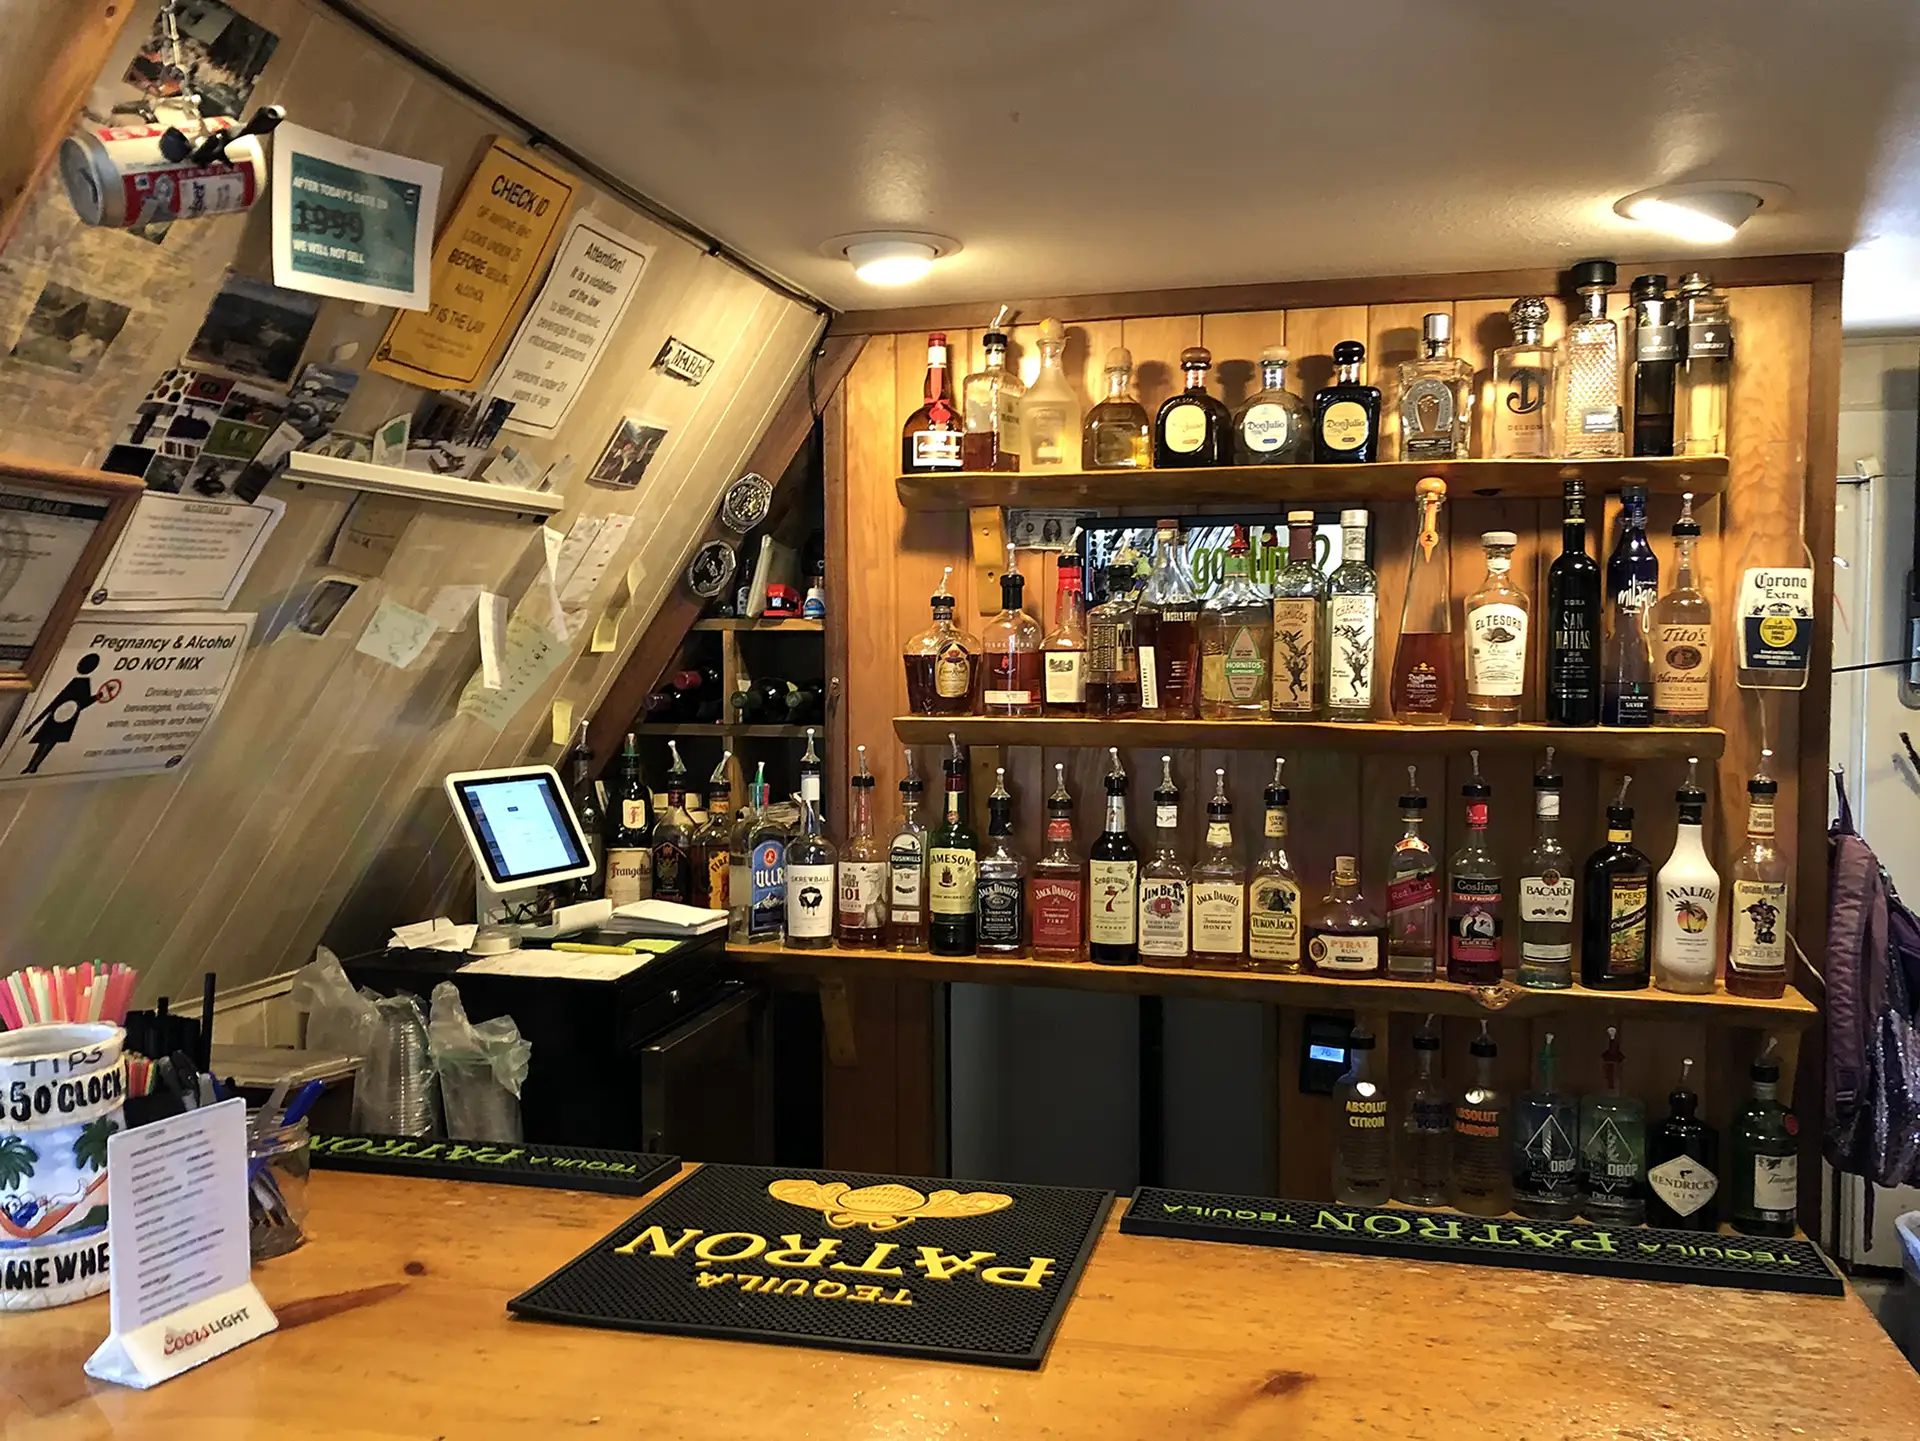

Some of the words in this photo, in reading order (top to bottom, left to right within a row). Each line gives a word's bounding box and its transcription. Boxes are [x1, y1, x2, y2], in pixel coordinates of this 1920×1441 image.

[491, 175, 535, 214] CHECK
[536, 199, 550, 217] ID
[293, 240, 306, 252] WE
[308, 242, 328, 257] WILL
[347, 249, 365, 264] SELL
[584, 242, 628, 274] Attention!
[448, 248, 488, 276] BEFORE
[588, 275, 618, 295] violation
[568, 288, 578, 298] of
[578, 290, 589, 304] the
[588, 296, 601, 308] law
[450, 311, 470, 330] THE
[1755, 572, 1808, 588] Corona
[1766, 589, 1799, 600] Extra
[1486, 614, 1522, 630] TESORO
[1564, 611, 1584, 630] SAN
[90, 634, 172, 652] Pregnancy
[172, 635, 184, 649] &
[184, 634, 237, 648] Alcohol
[1556, 630, 1590, 650] MATIAS
[1663, 628, 1706, 642] Tito's
[114, 658, 140, 670] DO
[141, 657, 176, 670] NOT
[176, 656, 204, 670] MIX
[145, 687, 182, 698] Drinking
[176, 702, 214, 714] including
[134, 718, 166, 726] coolers
[168, 716, 184, 726] and
[186, 716, 206, 725] beer
[756, 868, 784, 886] ULLR
[841, 888, 860, 901] 101
[979, 887, 994, 898] JACK
[994, 884, 1019, 899] DANIEL'S
[1036, 888, 1052, 900] JACK
[1052, 885, 1076, 901] DANIEL'S
[1104, 886, 1118, 912] 7
[1142, 887, 1158, 902] JIM
[1160, 885, 1185, 903] BEAM
[1197, 894, 1214, 906] JACK
[1214, 890, 1240, 906] DANIEL'S
[1624, 899, 1640, 907] RUM
[1253, 918, 1276, 928] YUKON
[1276, 918, 1294, 930] JACK
[12, 1046, 104, 1076] TIPS
[10, 1082, 32, 1122] 5
[34, 1067, 122, 1115] O'CLOCK
[1346, 1101, 1387, 1113] ABSOLUT
[1349, 1116, 1385, 1128] CITRON
[530, 1155, 636, 1174] TEQUILA
[1673, 1192, 1696, 1200] GIN
[1162, 1202, 1298, 1224] TEQUILA
[1638, 1242, 1801, 1266] TEQUILA
[0, 1242, 110, 1291] MEWHE
[695, 1272, 912, 1306] TEQUILA
[163, 1329, 210, 1356] Coors
[209, 1307, 252, 1335] LIGHT
